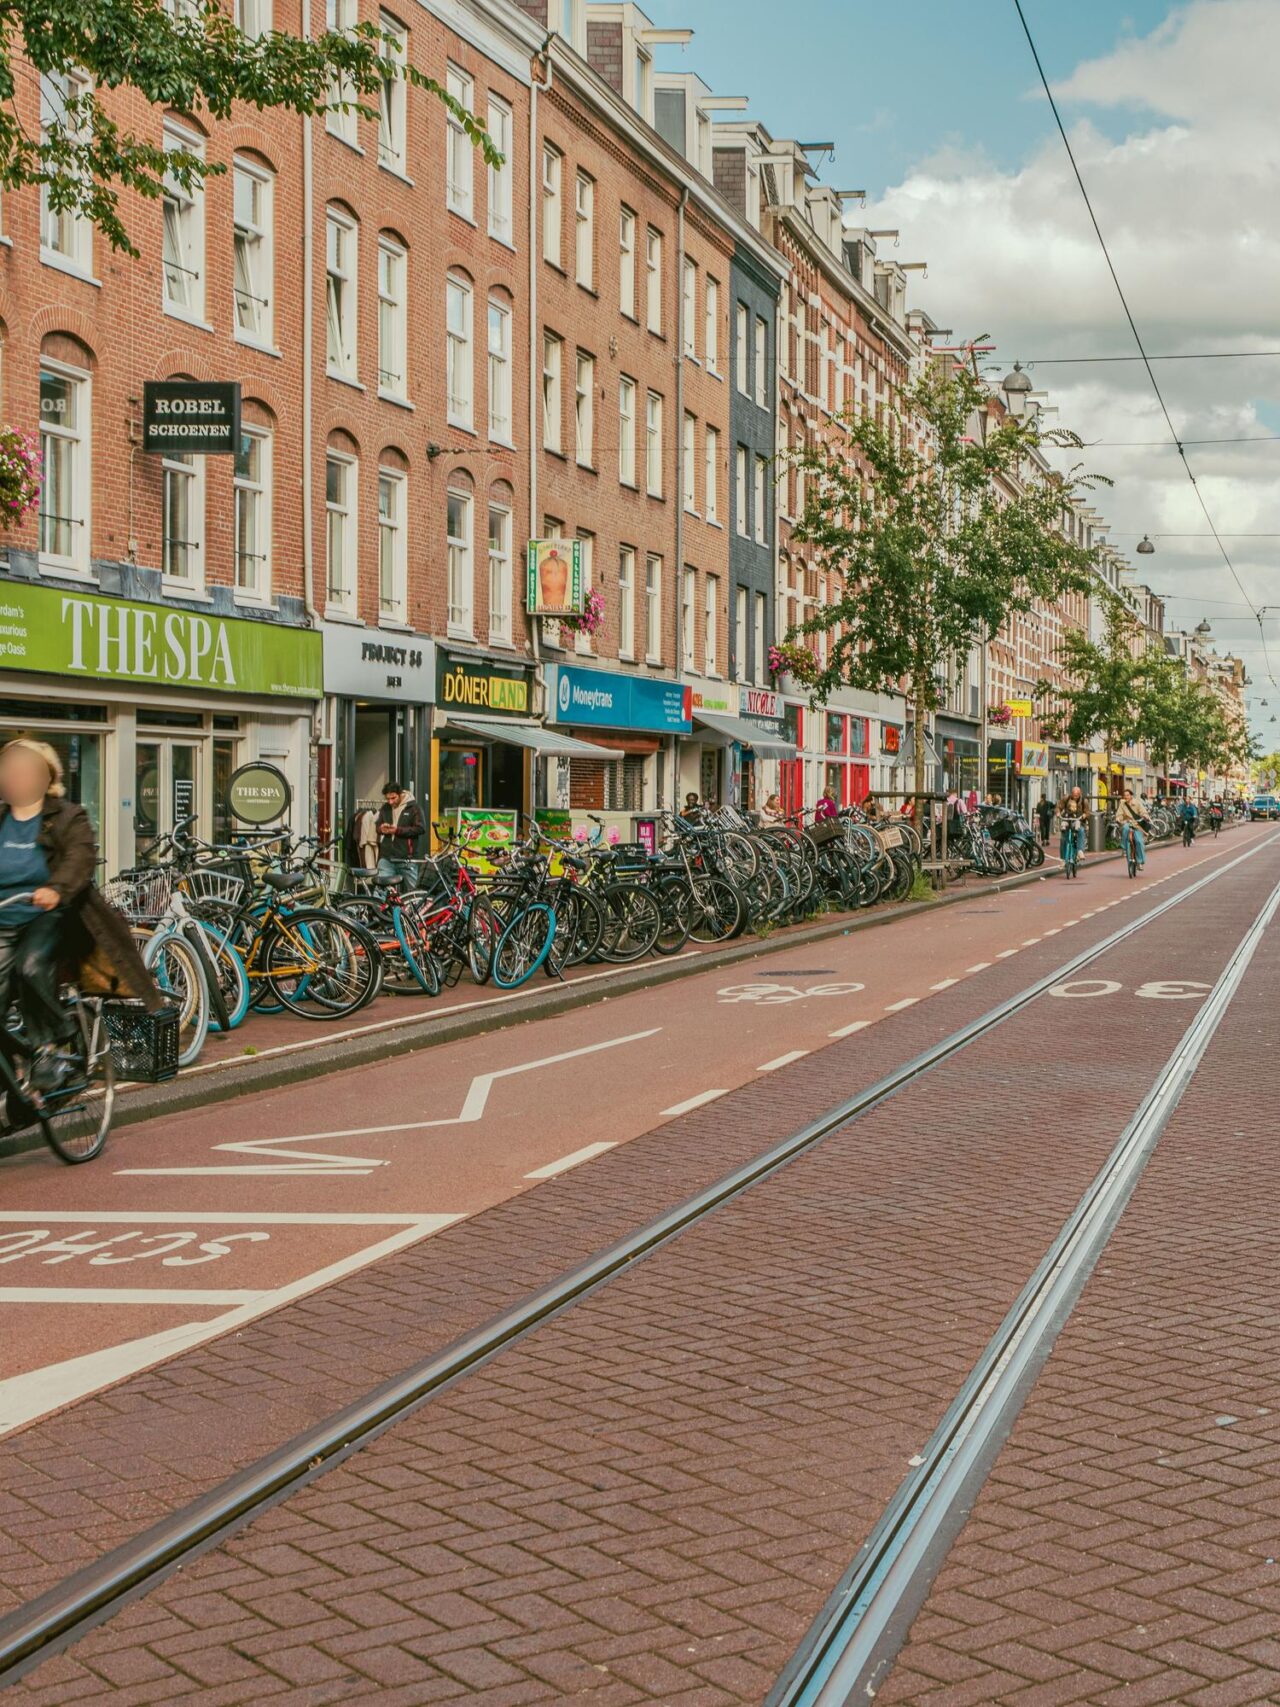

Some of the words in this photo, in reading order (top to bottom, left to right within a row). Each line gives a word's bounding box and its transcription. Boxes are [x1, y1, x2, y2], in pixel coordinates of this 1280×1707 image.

[155, 399, 225, 414] ROBEL
[149, 424, 231, 437] SCHOENEN
[62, 597, 157, 678] THE
[164, 613, 237, 685] SPA
[361, 642, 406, 666] PROJECT
[572, 685, 613, 710] Moneytrans
[236, 786, 259, 797] THE
[260, 787, 281, 798] SPA
